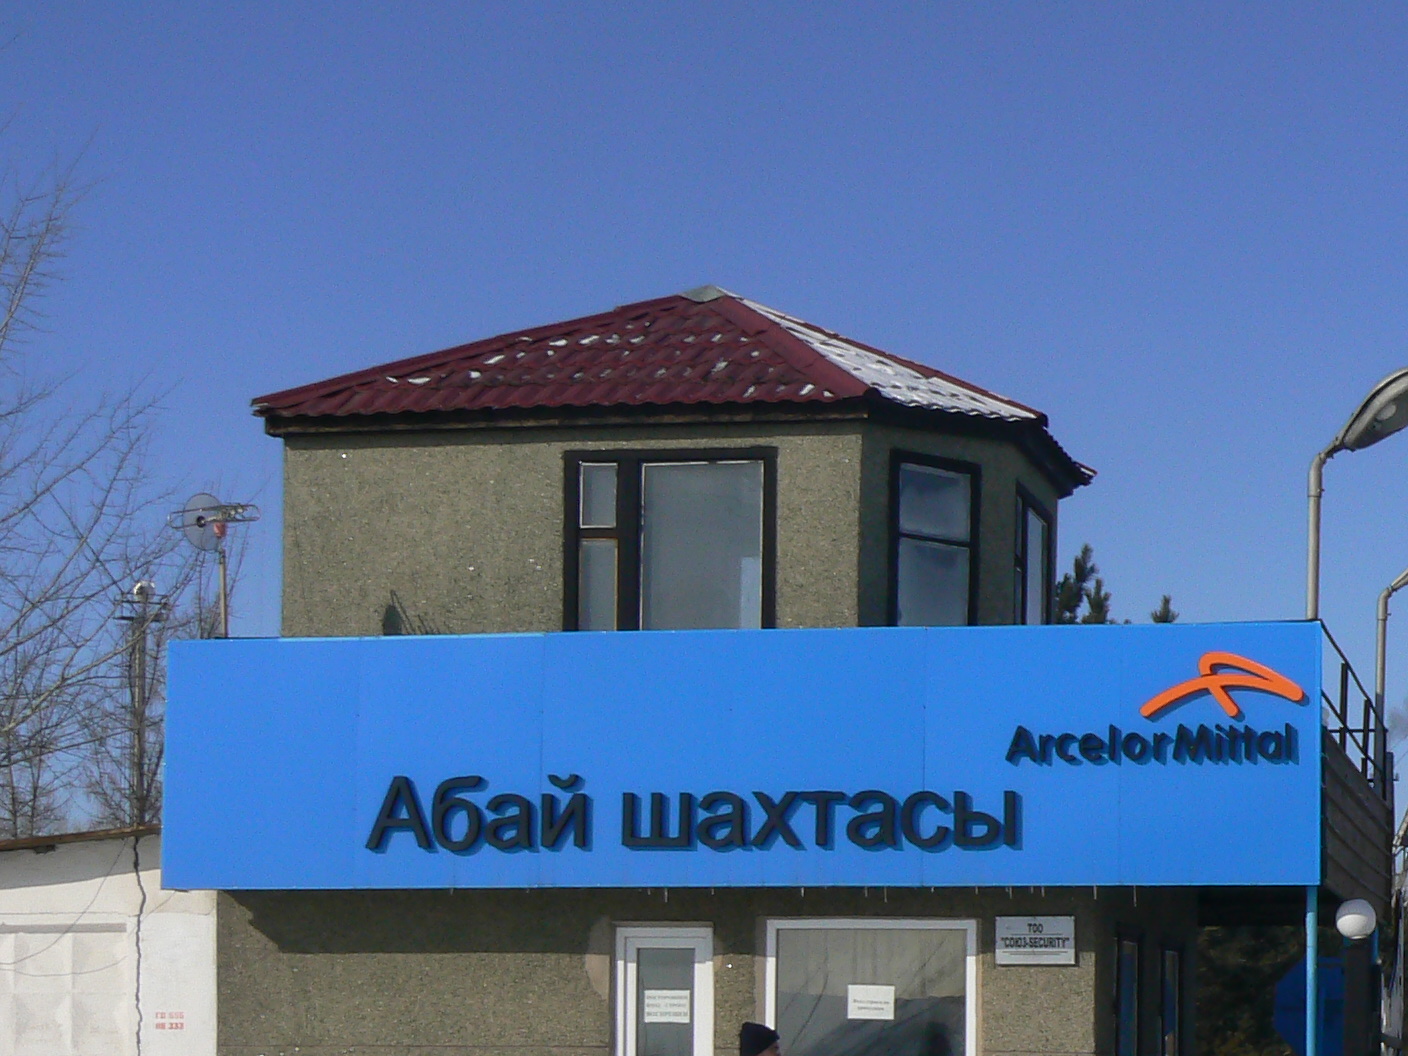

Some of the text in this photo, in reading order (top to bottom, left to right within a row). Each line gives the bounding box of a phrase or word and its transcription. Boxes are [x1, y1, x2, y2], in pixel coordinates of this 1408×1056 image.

[1005, 723, 1299, 765] ArcelorMittal
[366, 773, 1022, 853] Абай шахтасы
